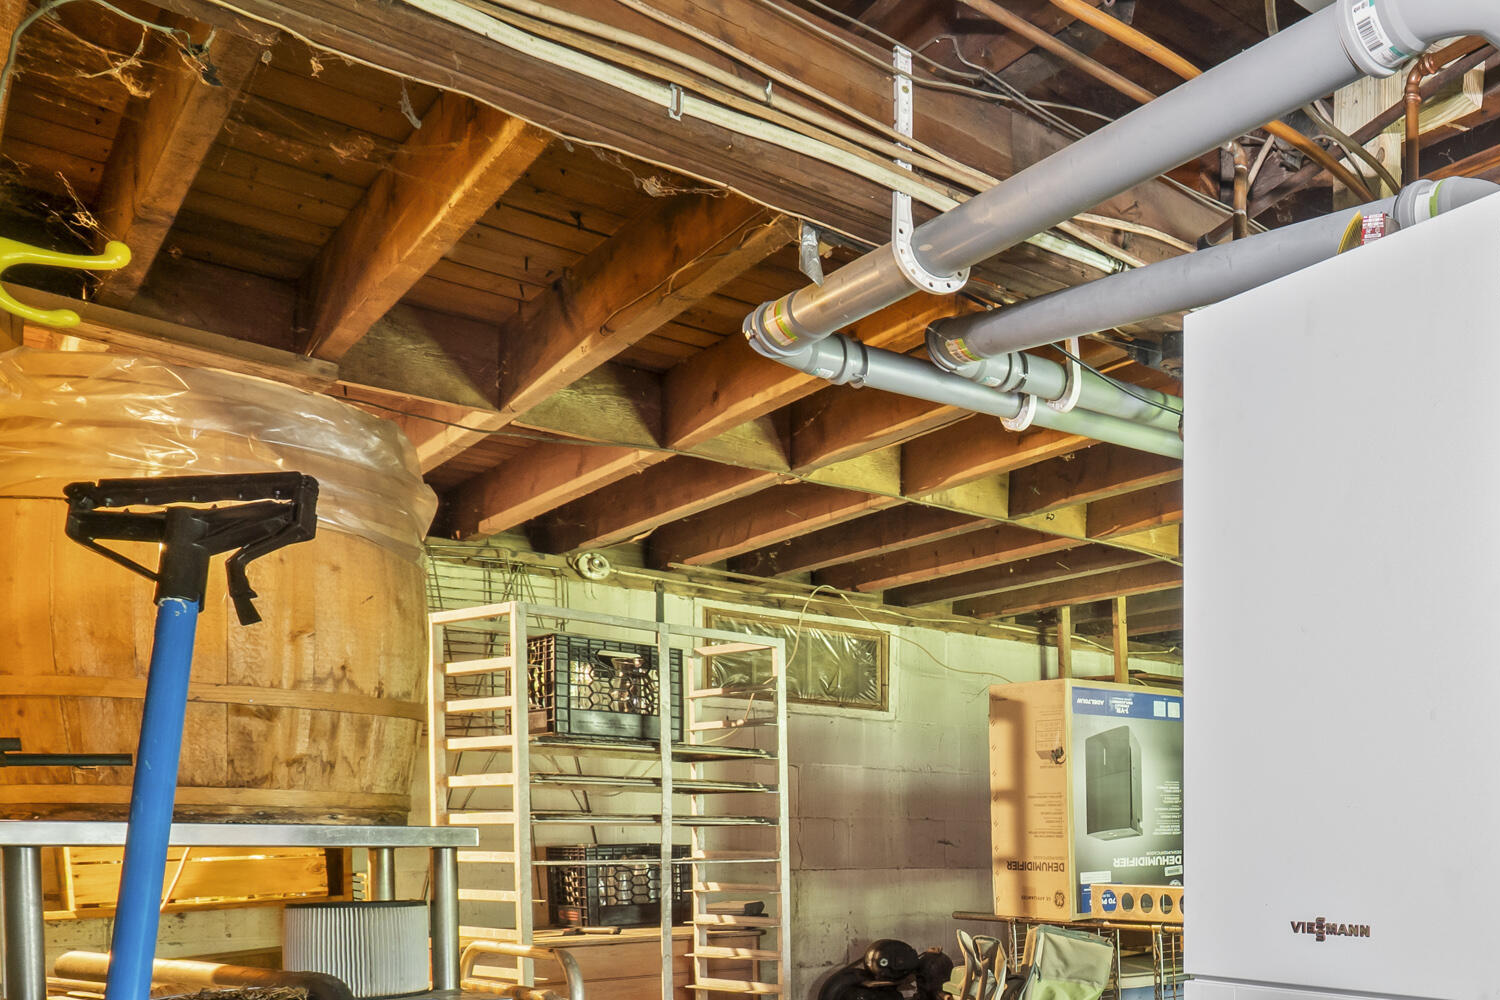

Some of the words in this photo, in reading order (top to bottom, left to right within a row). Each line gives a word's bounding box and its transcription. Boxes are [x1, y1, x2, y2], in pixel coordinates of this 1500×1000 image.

[1006, 860, 1065, 873] DEHUMIDIFIER
[1113, 855, 1183, 868] DEHUMIDIFIER
[1290, 916, 1371, 942] VIESSMANN
